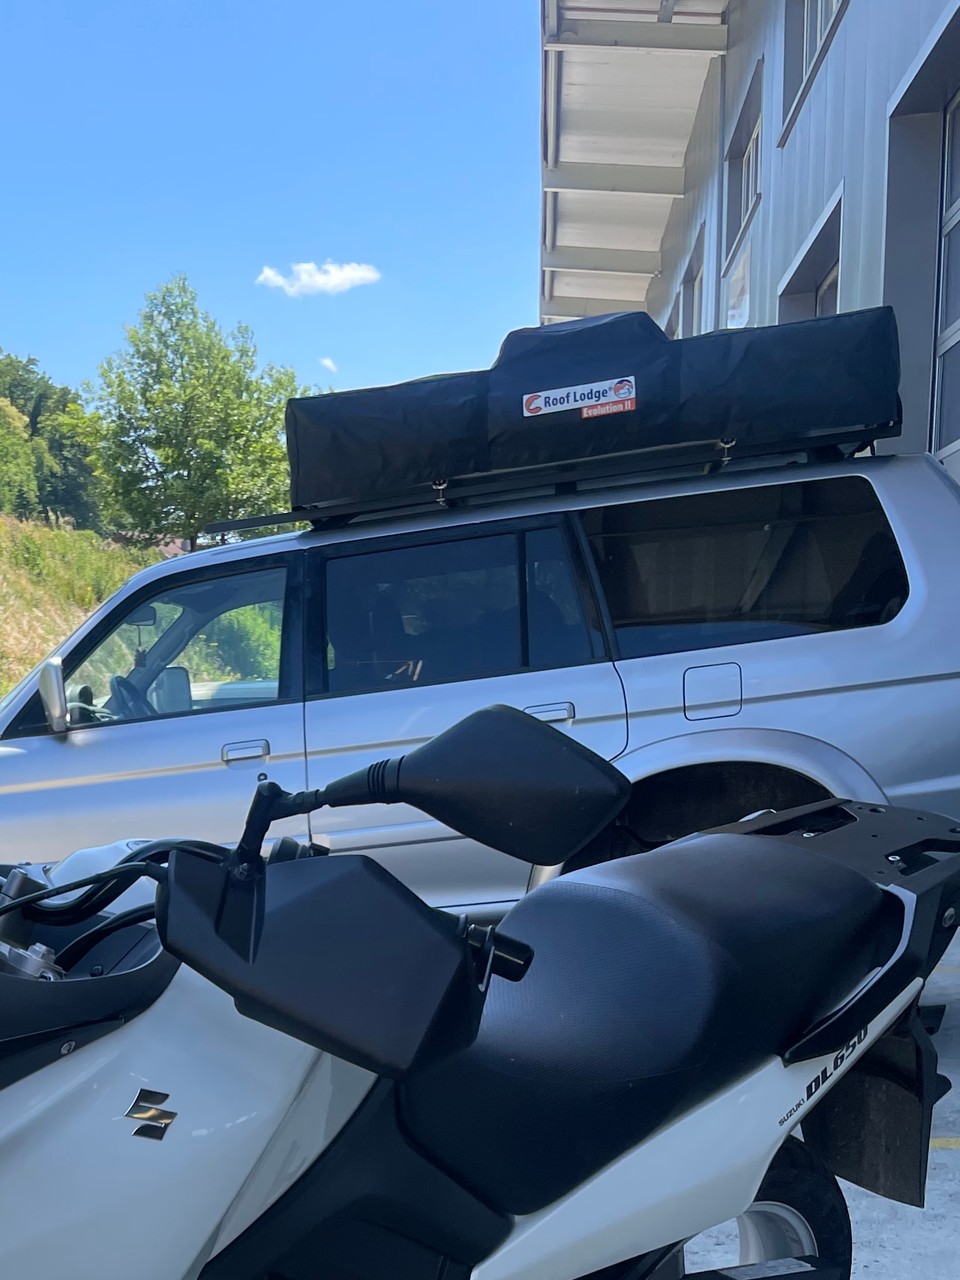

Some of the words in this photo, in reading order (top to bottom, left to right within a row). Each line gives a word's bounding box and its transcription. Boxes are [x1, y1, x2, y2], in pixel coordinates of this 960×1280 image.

[544, 391, 571, 408] Roof
[583, 402, 624, 417] Evolution
[805, 1024, 869, 1101] DL650
[778, 1098, 805, 1127] SUZUKI
